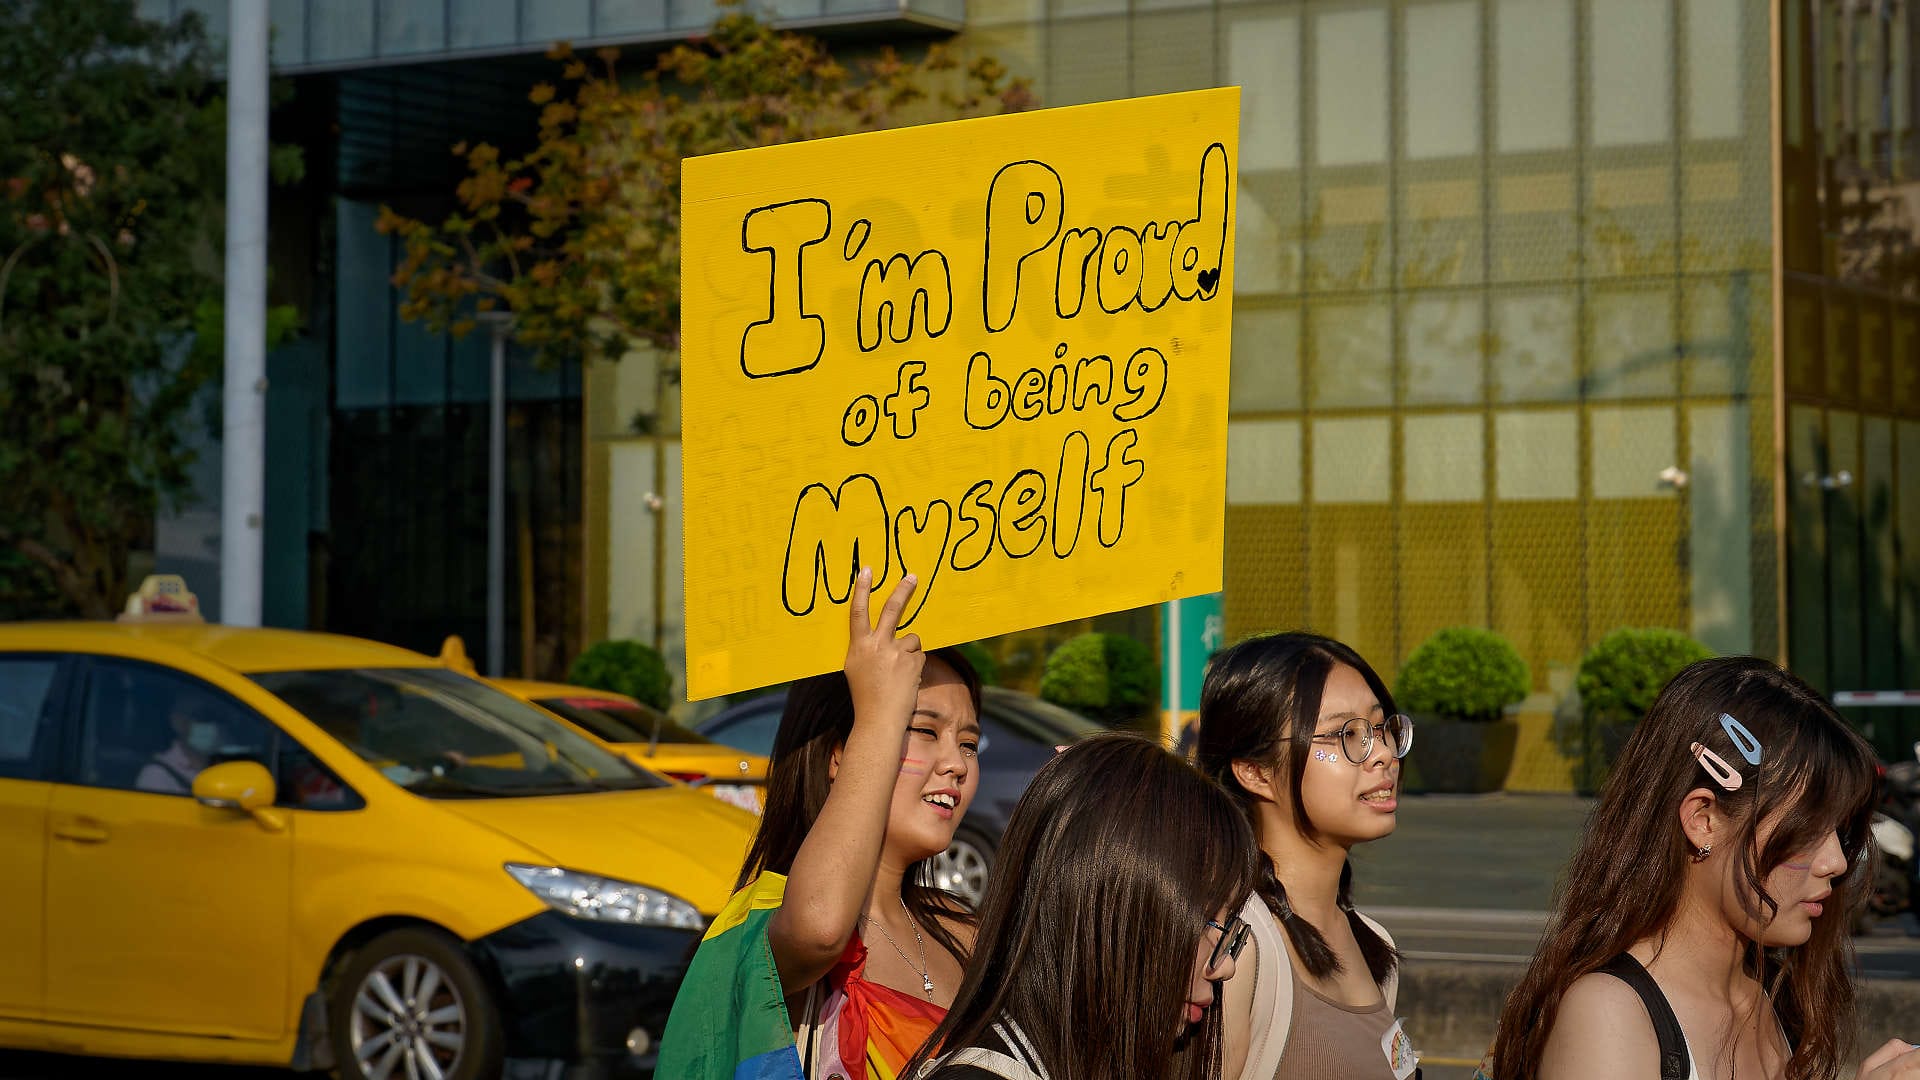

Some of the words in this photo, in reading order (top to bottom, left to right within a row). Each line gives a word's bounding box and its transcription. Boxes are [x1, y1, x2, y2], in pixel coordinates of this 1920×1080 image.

[740, 198, 953, 379] I'm
[982, 142, 1230, 334] Proud
[841, 361, 930, 447] of
[964, 343, 1168, 430] being
[781, 428, 1145, 632] Myself
